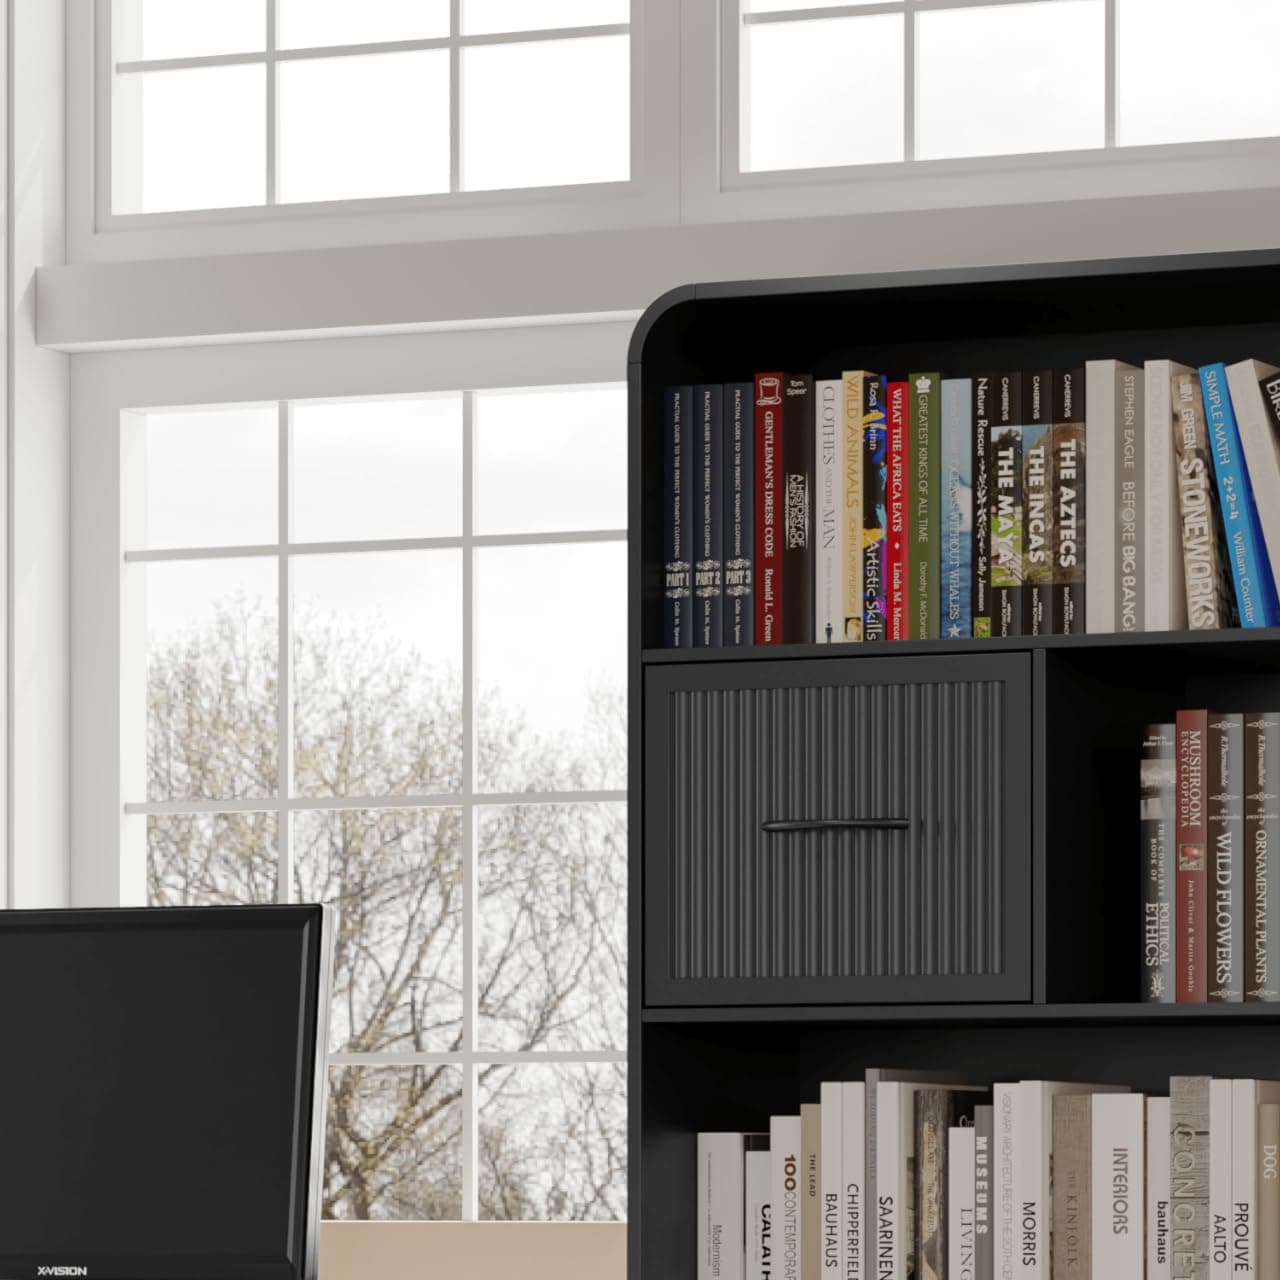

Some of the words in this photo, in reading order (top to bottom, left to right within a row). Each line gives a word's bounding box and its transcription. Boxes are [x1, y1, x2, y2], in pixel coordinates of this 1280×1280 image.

[918, 395, 928, 444] GREATEST
[1205, 371, 1223, 420] SIMPLE
[1215, 423, 1230, 464] MATH
[918, 448, 928, 478] KINGS
[918, 481, 928, 494] OF
[998, 447, 1014, 488] THE
[1029, 446, 1044, 486] THE
[1060, 439, 1076, 479] THE
[765, 492, 773, 525] DRESS
[918, 498, 928, 516] ALL
[918, 519, 928, 542] TIME
[998, 495, 1014, 564] MAYA
[1029, 494, 1044, 563] INCAS
[1060, 486, 1076, 567] AZTECS
[765, 528, 773, 557] CODE
[1180, 458, 1215, 628] STONEWORKS
[1181, 731, 1189, 827] ENCYCLOPEDIA
[1189, 731, 1201, 826] MUSHROOM
[1216, 832, 1232, 885] WILD
[1256, 830, 1267, 927] ORNAMENTAL
[1145, 902, 1158, 966] ETHICS
[1158, 902, 1169, 966] POLITICAL
[1216, 889, 1232, 983] FLOWERS
[1256, 931, 1267, 983] PLANTS
[976, 1136, 987, 1234] MUSEUMS
[1113, 1148, 1128, 1235] INTERIORS
[1263, 1145, 1277, 1179] DOG
[711, 1225, 722, 1276] Modernism
[825, 1193, 837, 1268] BAUHAUS
[1022, 1202, 1036, 1266] MORRIS
[1066, 1195, 1078, 1267] KINFOLK
[1157, 1201, 1169, 1264] bauhaus
[1214, 1214, 1227, 1263] AALTO
[1234, 1203, 1253, 1272] PROUVÉ
